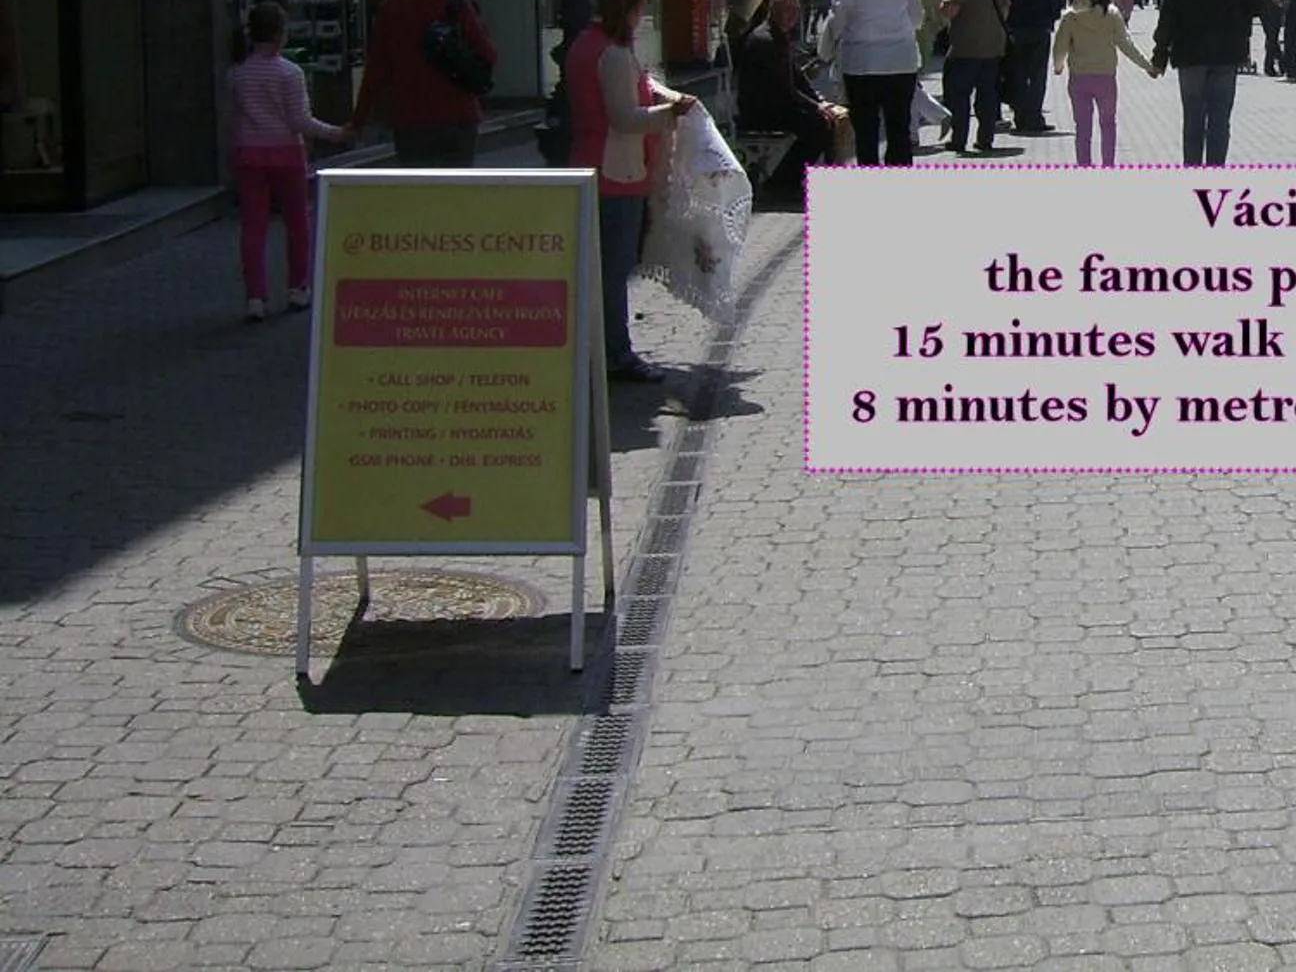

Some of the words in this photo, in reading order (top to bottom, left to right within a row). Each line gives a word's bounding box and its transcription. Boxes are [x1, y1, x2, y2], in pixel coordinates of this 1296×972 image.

[370, 232, 475, 254] BUSINESS
[479, 232, 566, 254] CENTER
[377, 373, 412, 387] CALL
[469, 373, 530, 387] TELEFON
[349, 399, 399, 414] PHOTO
